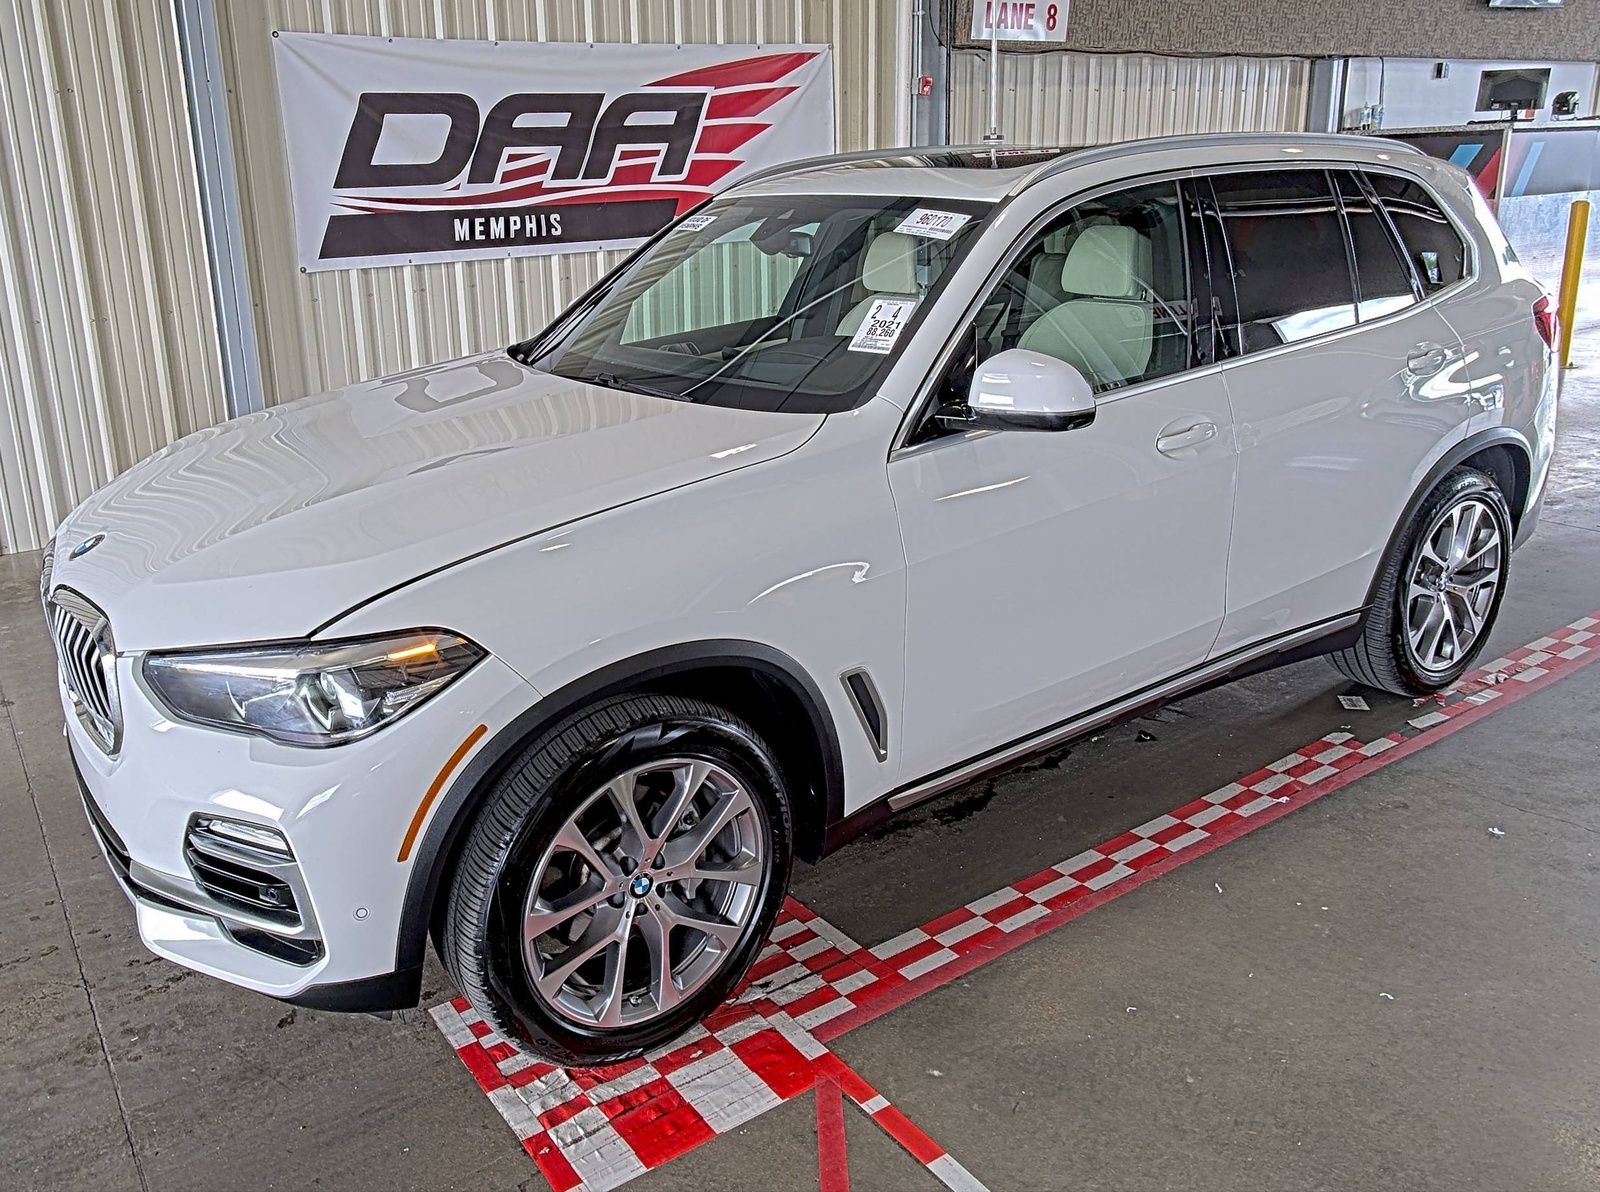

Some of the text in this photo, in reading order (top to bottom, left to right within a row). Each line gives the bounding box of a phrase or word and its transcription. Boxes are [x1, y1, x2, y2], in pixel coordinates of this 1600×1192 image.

[985, 2, 1058, 31] LANE 8
[333, 93, 708, 188] DAA
[454, 212, 563, 242] MEMPHIS
[915, 212, 953, 228] 960170
[871, 305, 903, 320] 2 4
[866, 327, 896, 338] 88,260
[871, 319, 901, 330] 2021
